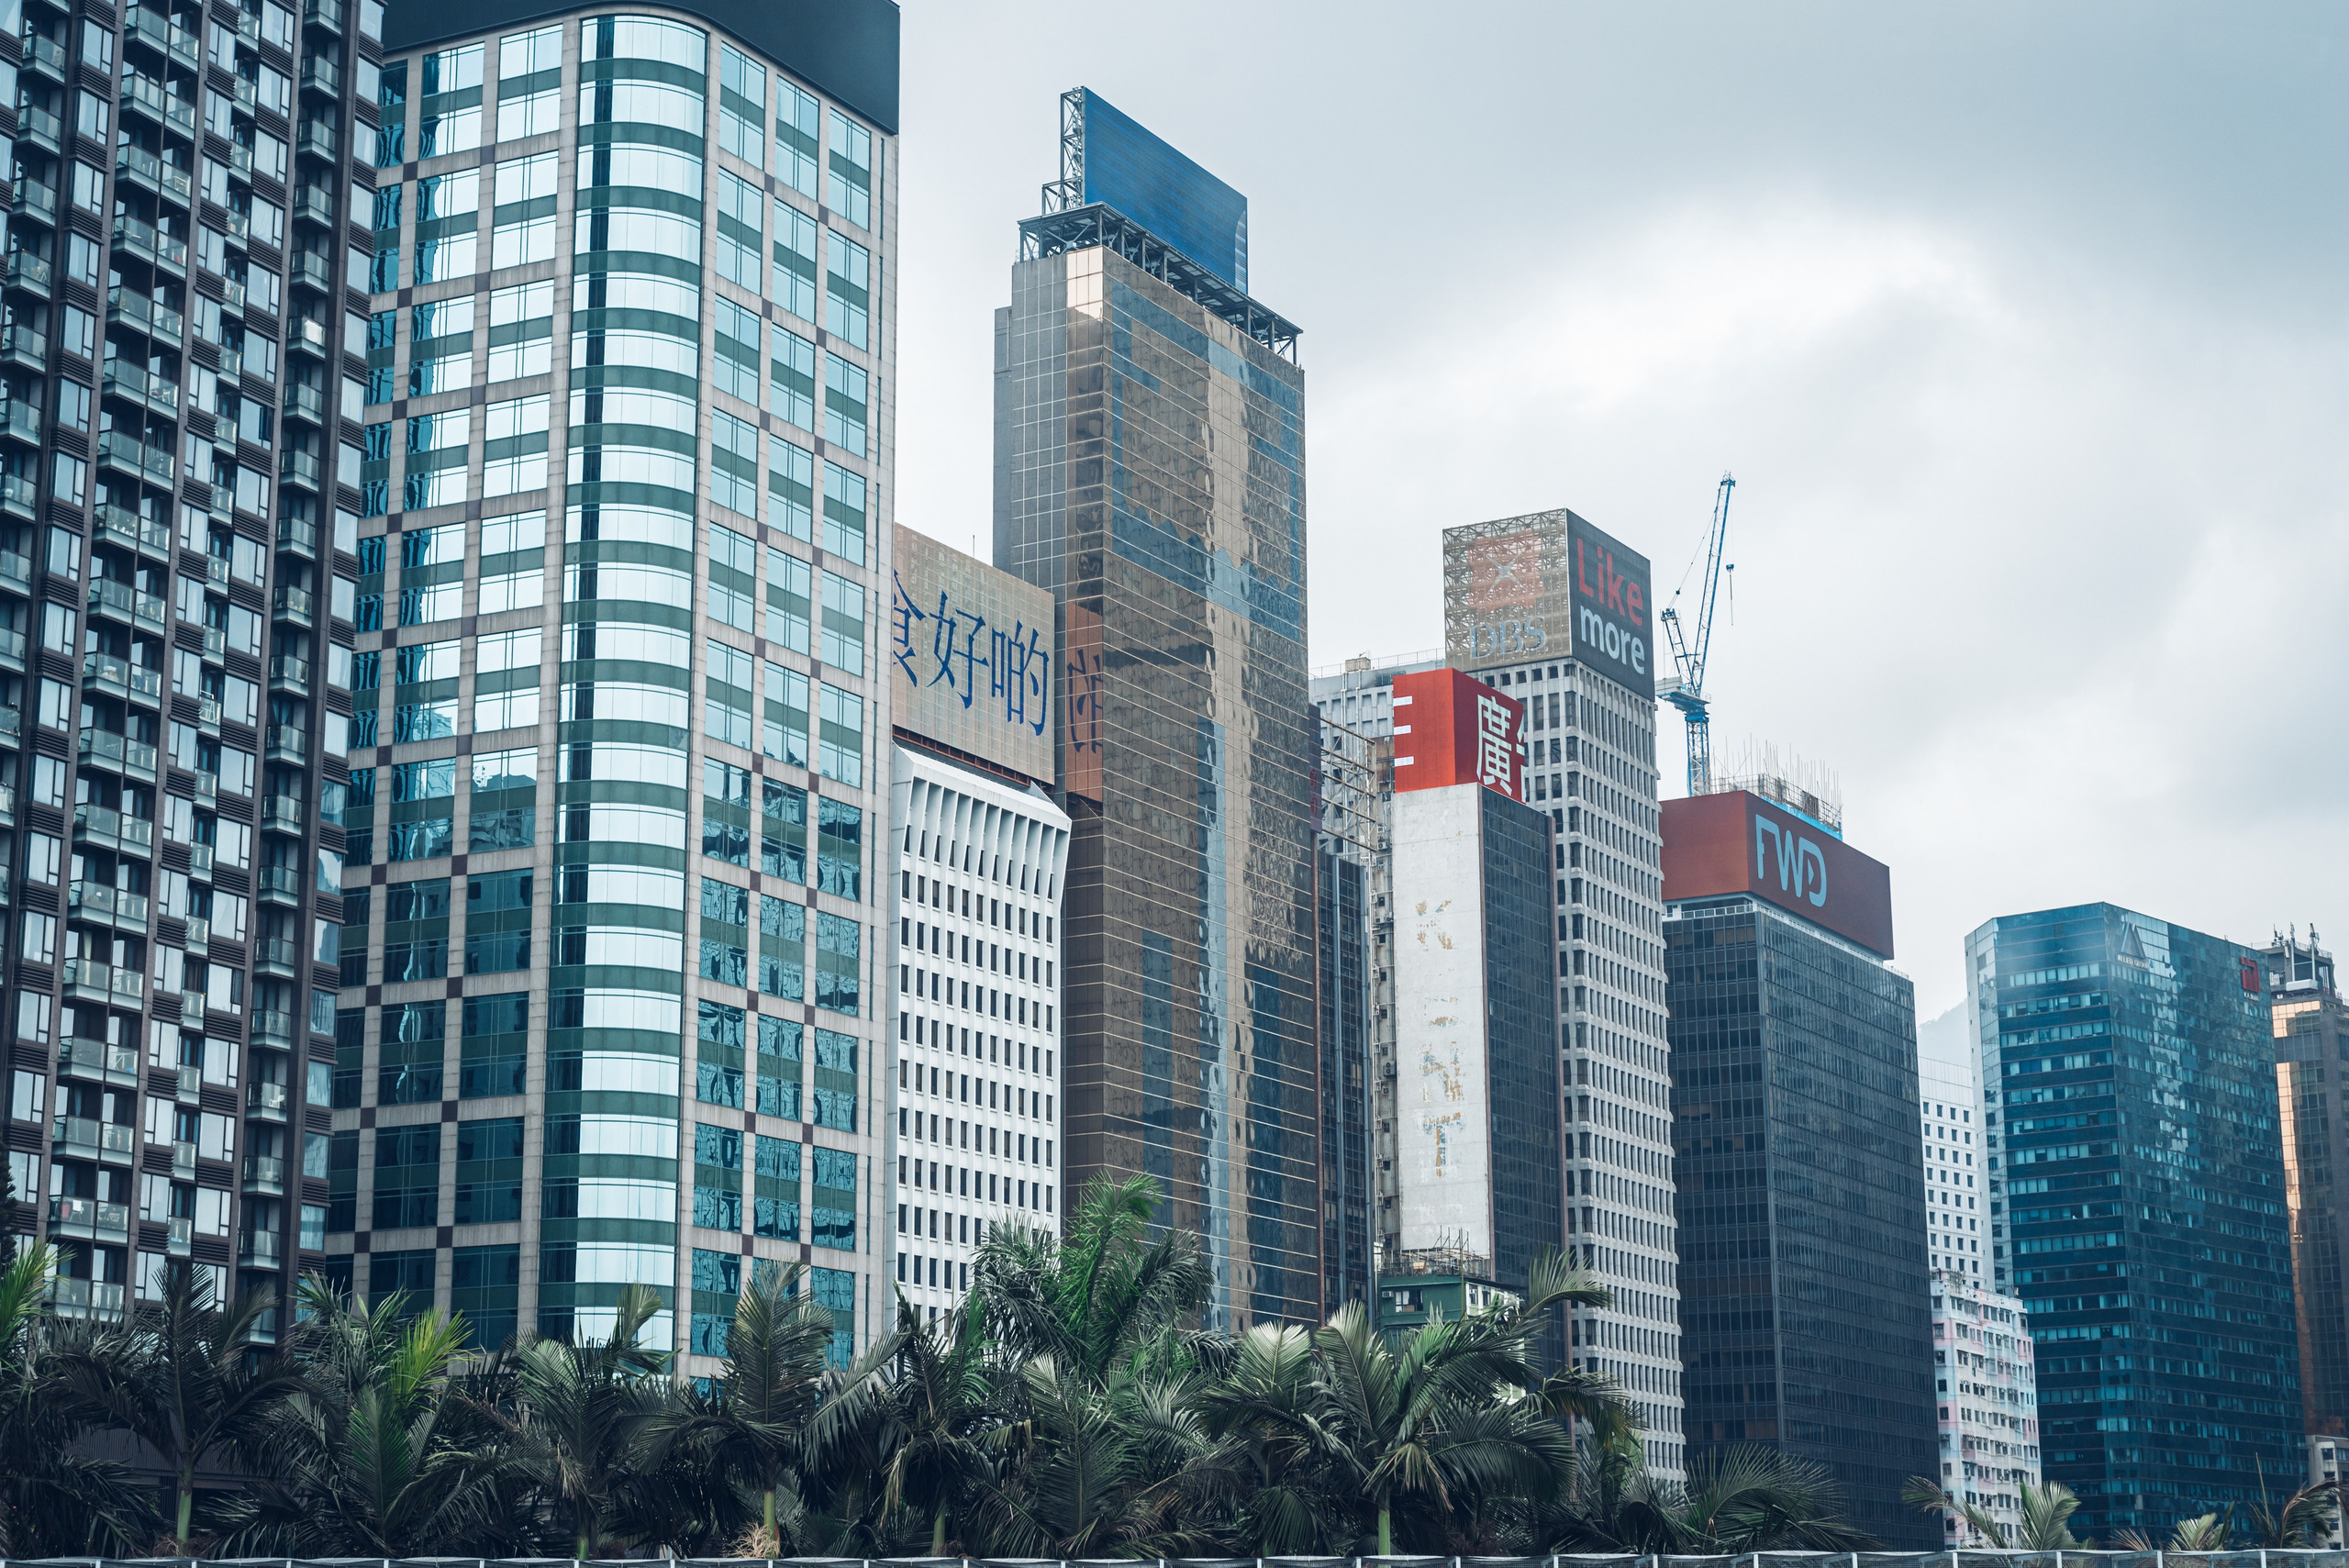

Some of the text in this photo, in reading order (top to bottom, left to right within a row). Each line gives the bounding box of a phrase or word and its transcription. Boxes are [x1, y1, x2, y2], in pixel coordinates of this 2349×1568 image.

[1577, 538, 1643, 627] Like
[1470, 616, 1546, 660] DBS
[1580, 604, 1645, 675] more
[1476, 695, 1527, 805] 廣
[1755, 814, 1827, 907] FWD
